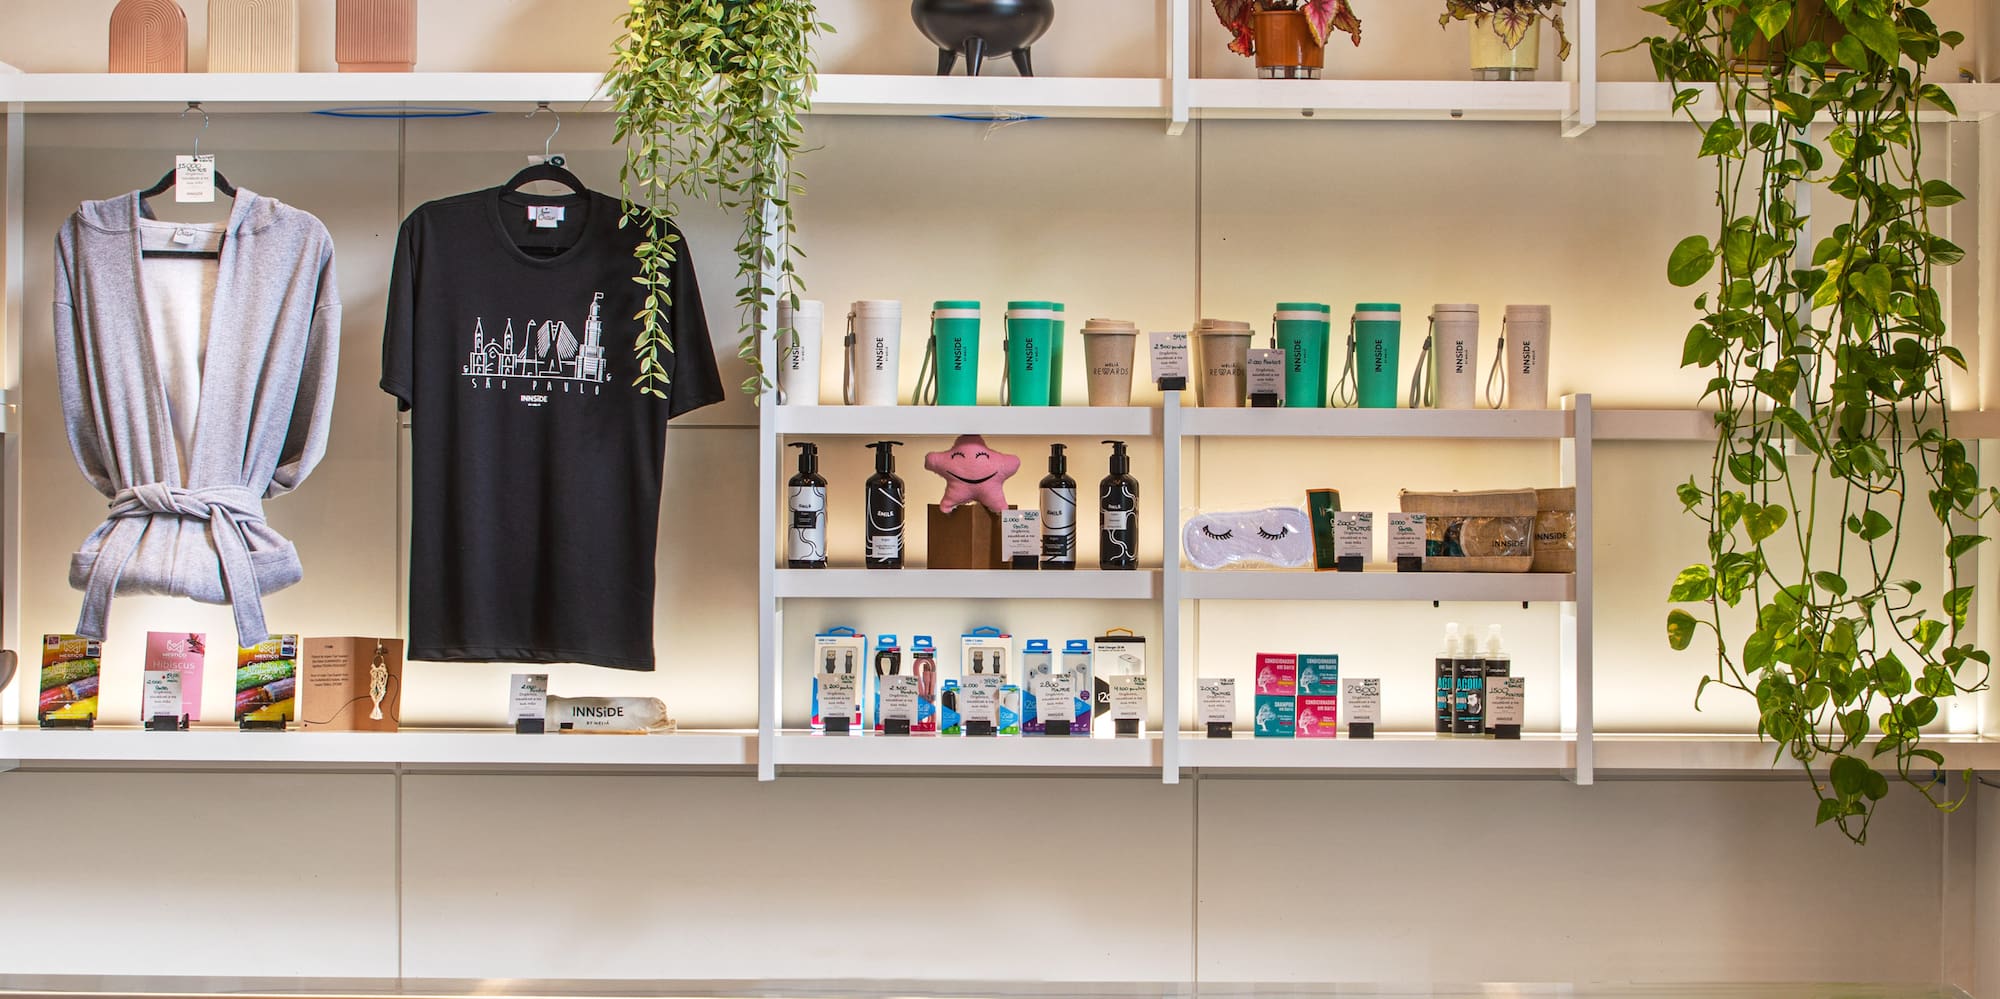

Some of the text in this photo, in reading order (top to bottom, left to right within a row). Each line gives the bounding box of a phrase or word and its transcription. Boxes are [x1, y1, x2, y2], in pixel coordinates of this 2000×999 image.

[472, 378, 600, 395] SÃO PAULO
[152, 660, 195, 669] Hibiscus
[573, 706, 624, 717] INNSiDE
